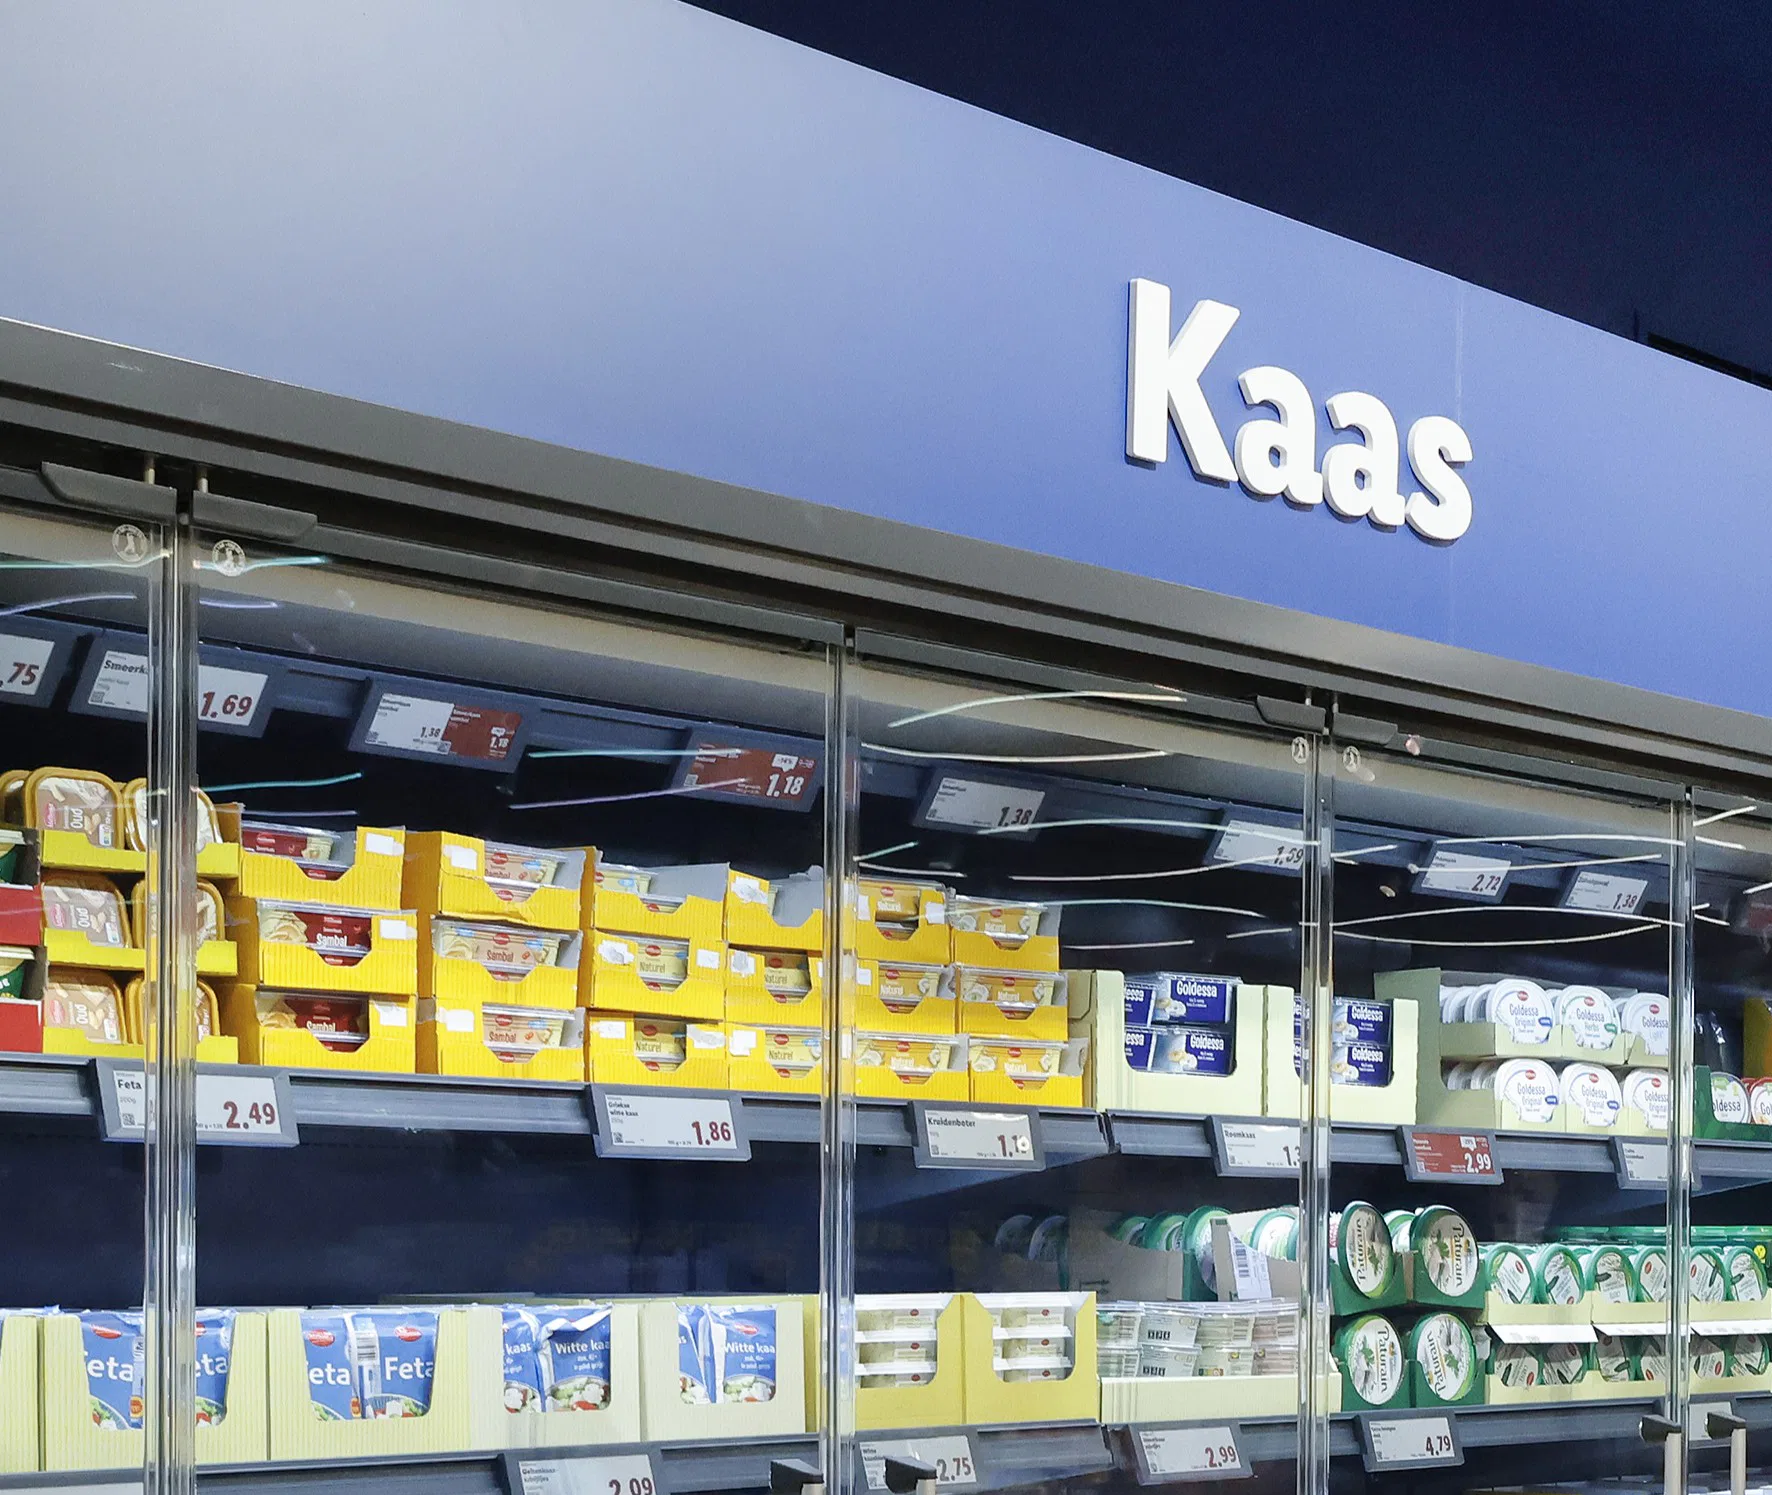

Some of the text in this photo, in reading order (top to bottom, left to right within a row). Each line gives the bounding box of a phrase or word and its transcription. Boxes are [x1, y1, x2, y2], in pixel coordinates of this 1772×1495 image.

[1125, 276, 1474, 543] Kaas
[103, 659, 148, 676] Smeerk
[199, 691, 253, 719] 1.69
[765, 772, 804, 798] 1.18
[996, 805, 1034, 827] 1.38
[1471, 873, 1502, 893] 2.72
[1612, 892, 1638, 911] 1.38
[485, 950, 515, 964] Sambal
[638, 961, 667, 974] Naturel
[1125, 988, 1145, 1002] essa
[1175, 979, 1218, 999] Goldessa
[1350, 1004, 1384, 1023] Goldessa
[1508, 1003, 1540, 1017] Goldessa
[1575, 1009, 1605, 1022] Goldessa
[487, 1031, 518, 1044] Sambal
[634, 1040, 663, 1054] Naturel
[1125, 1031, 1145, 1047] essa
[1189, 1033, 1225, 1052] Goldessa
[767, 1049, 794, 1062] Naturel
[1350, 1045, 1384, 1064] Goldessa
[117, 1078, 142, 1091] Feta
[1516, 1083, 1546, 1096] Goldessa
[1581, 1084, 1608, 1099] Goldessa
[222, 1100, 277, 1130] 2.49
[927, 1116, 976, 1128] Kruidenboter
[691, 1120, 732, 1147] 1.86
[1223, 1129, 1256, 1141] Roomkaas
[996, 1133, 1031, 1158] 1.1
[1463, 1152, 1492, 1174] 2.99
[1453, 1221, 1466, 1289] Paturain
[505, 1341, 532, 1355] kaas
[555, 1340, 611, 1355] Witte kaa
[723, 1342, 776, 1354] Witte kaa
[195, 1353, 230, 1379] eta
[384, 1355, 434, 1381] Feta
[1378, 1324, 1391, 1394] Paturain
[308, 1363, 352, 1386] eta
[1425, 1435, 1452, 1456] 4.79
[1205, 1444, 1237, 1470] 2.99
[936, 1456, 972, 1482] 2.75
